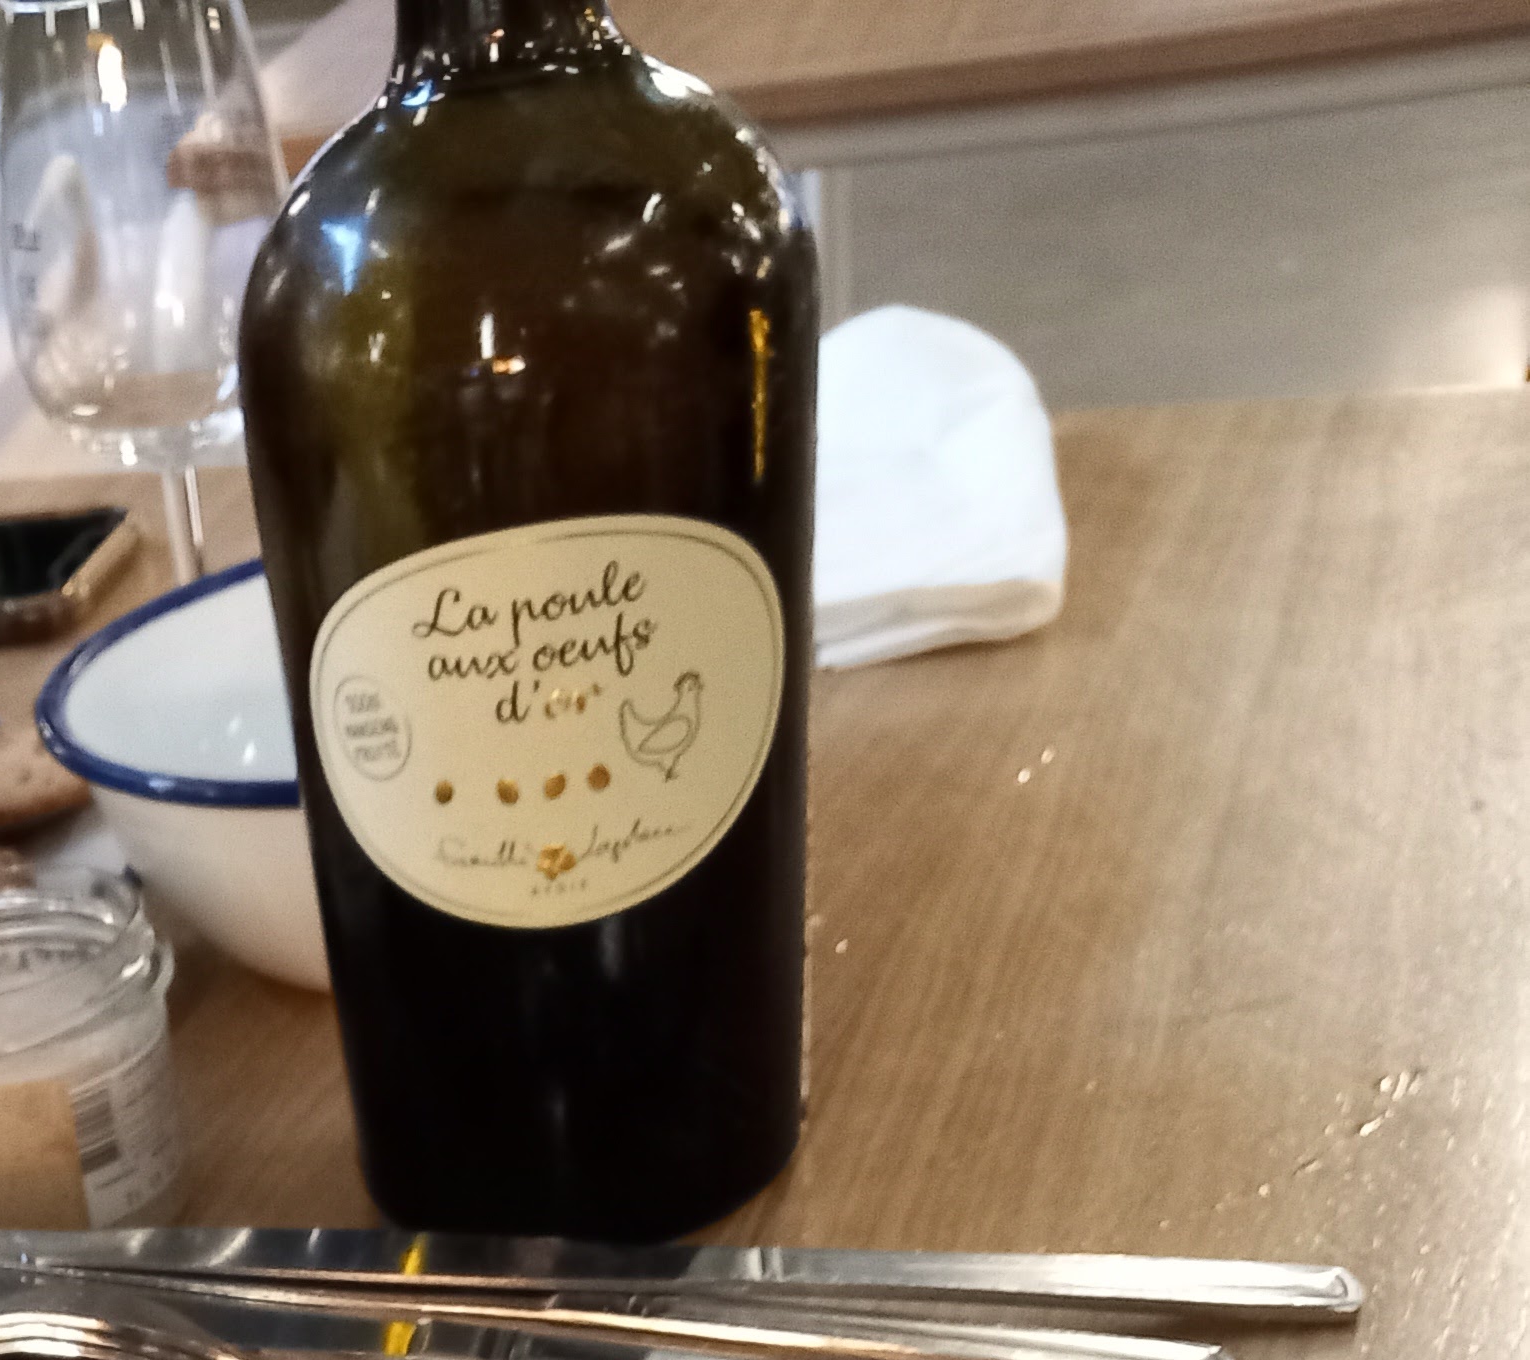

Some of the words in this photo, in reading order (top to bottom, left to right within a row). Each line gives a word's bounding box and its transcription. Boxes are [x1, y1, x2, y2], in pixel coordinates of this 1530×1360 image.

[411, 587, 499, 638] La
[510, 559, 648, 649] poule
[427, 649, 519, 682] aux
[531, 611, 658, 678] oeufs
